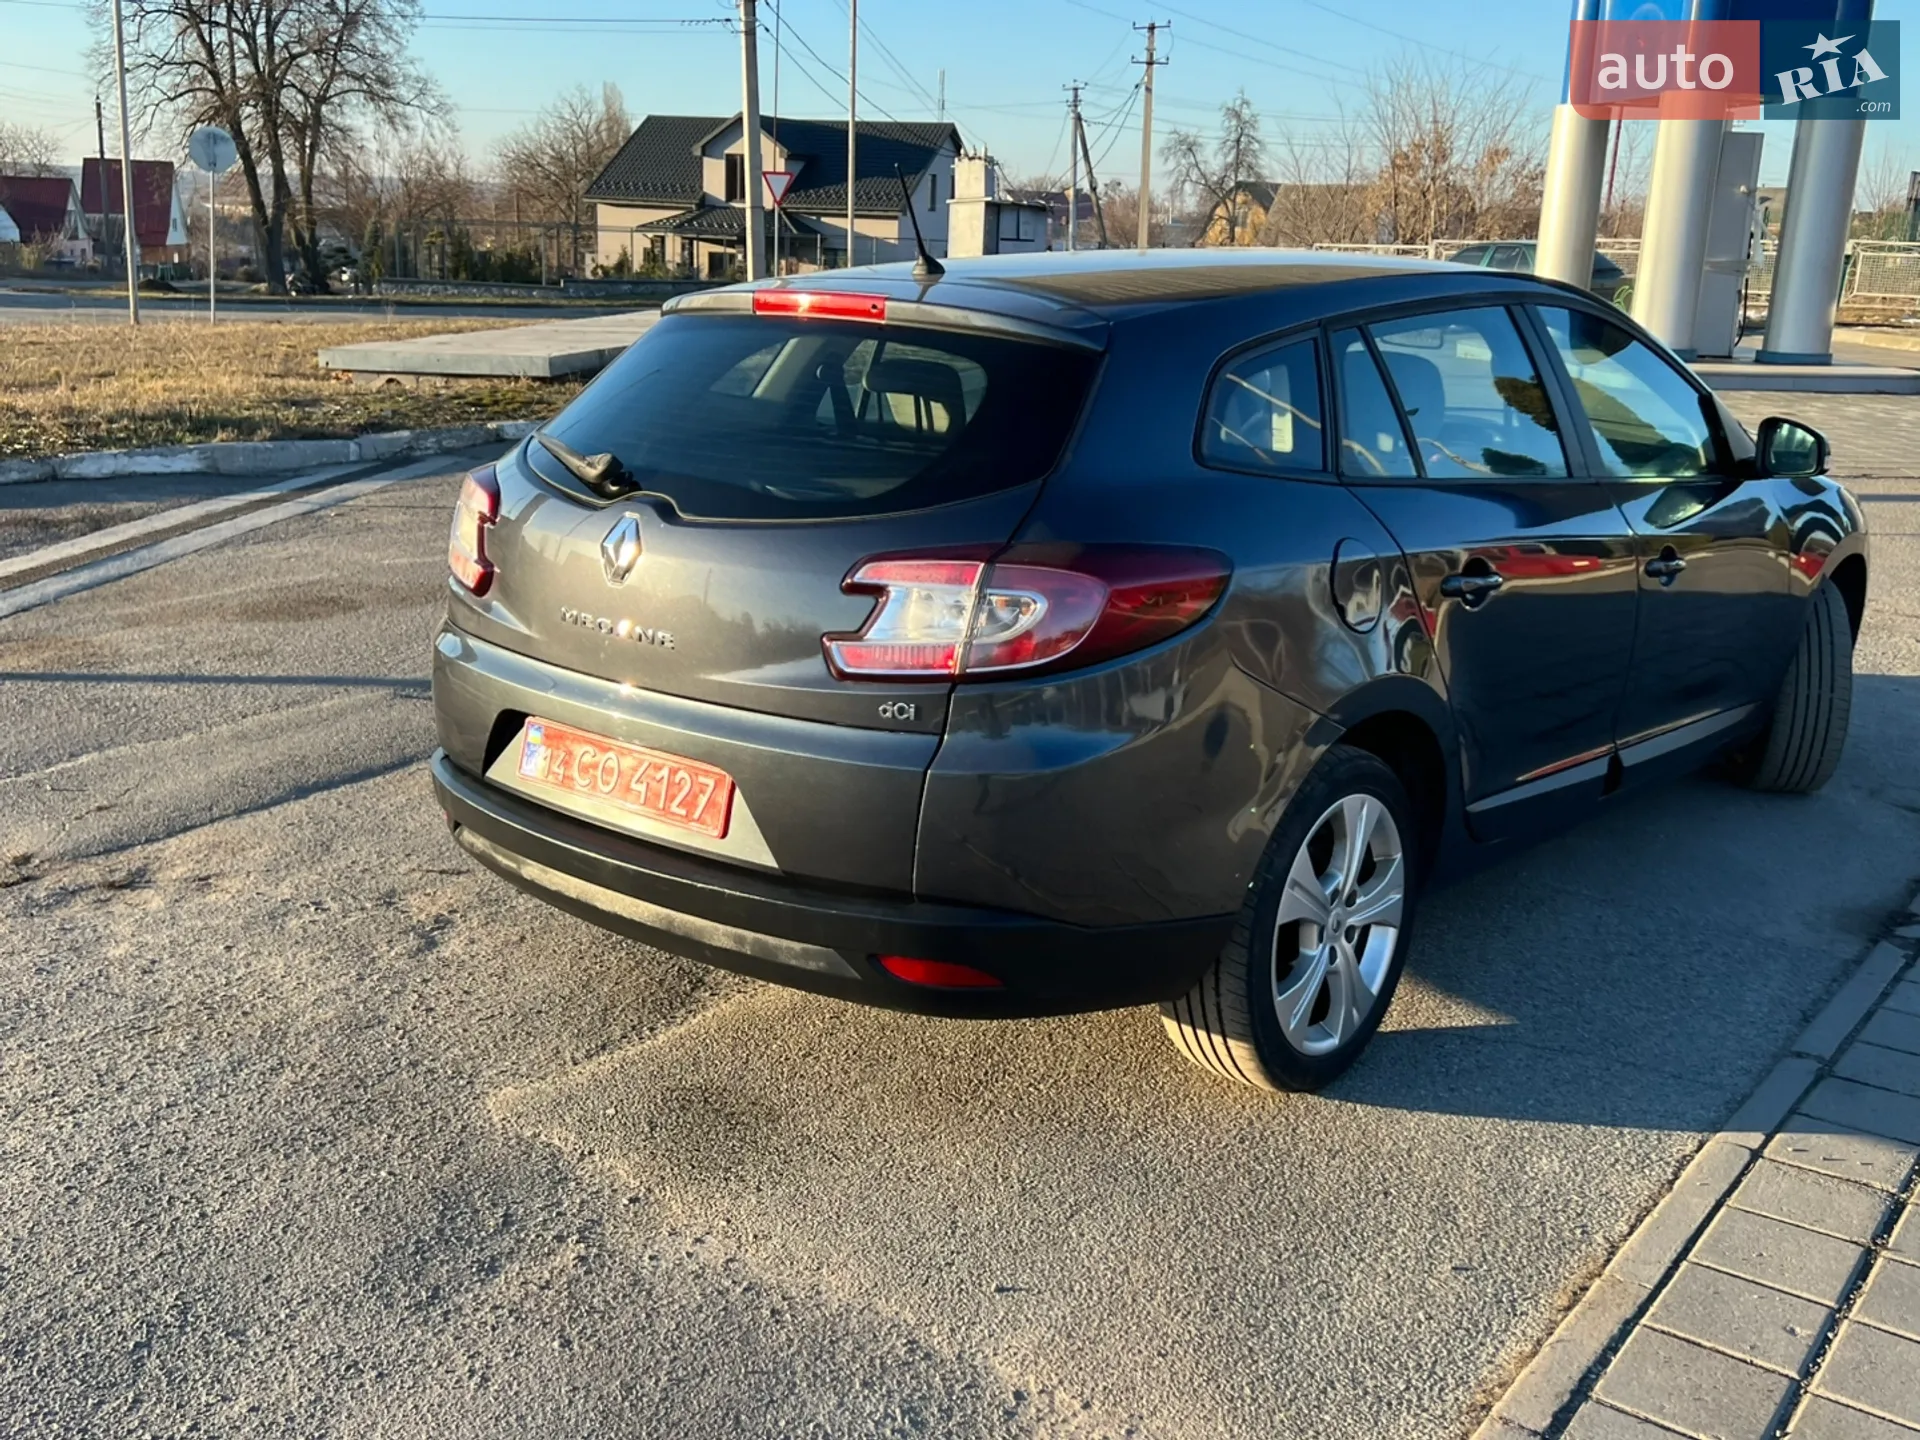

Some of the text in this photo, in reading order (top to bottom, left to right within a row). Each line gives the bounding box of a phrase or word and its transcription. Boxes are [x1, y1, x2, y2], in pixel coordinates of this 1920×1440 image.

[878, 701, 916, 721] dCi
[573, 745, 620, 795] CO
[630, 759, 716, 821] 4127
